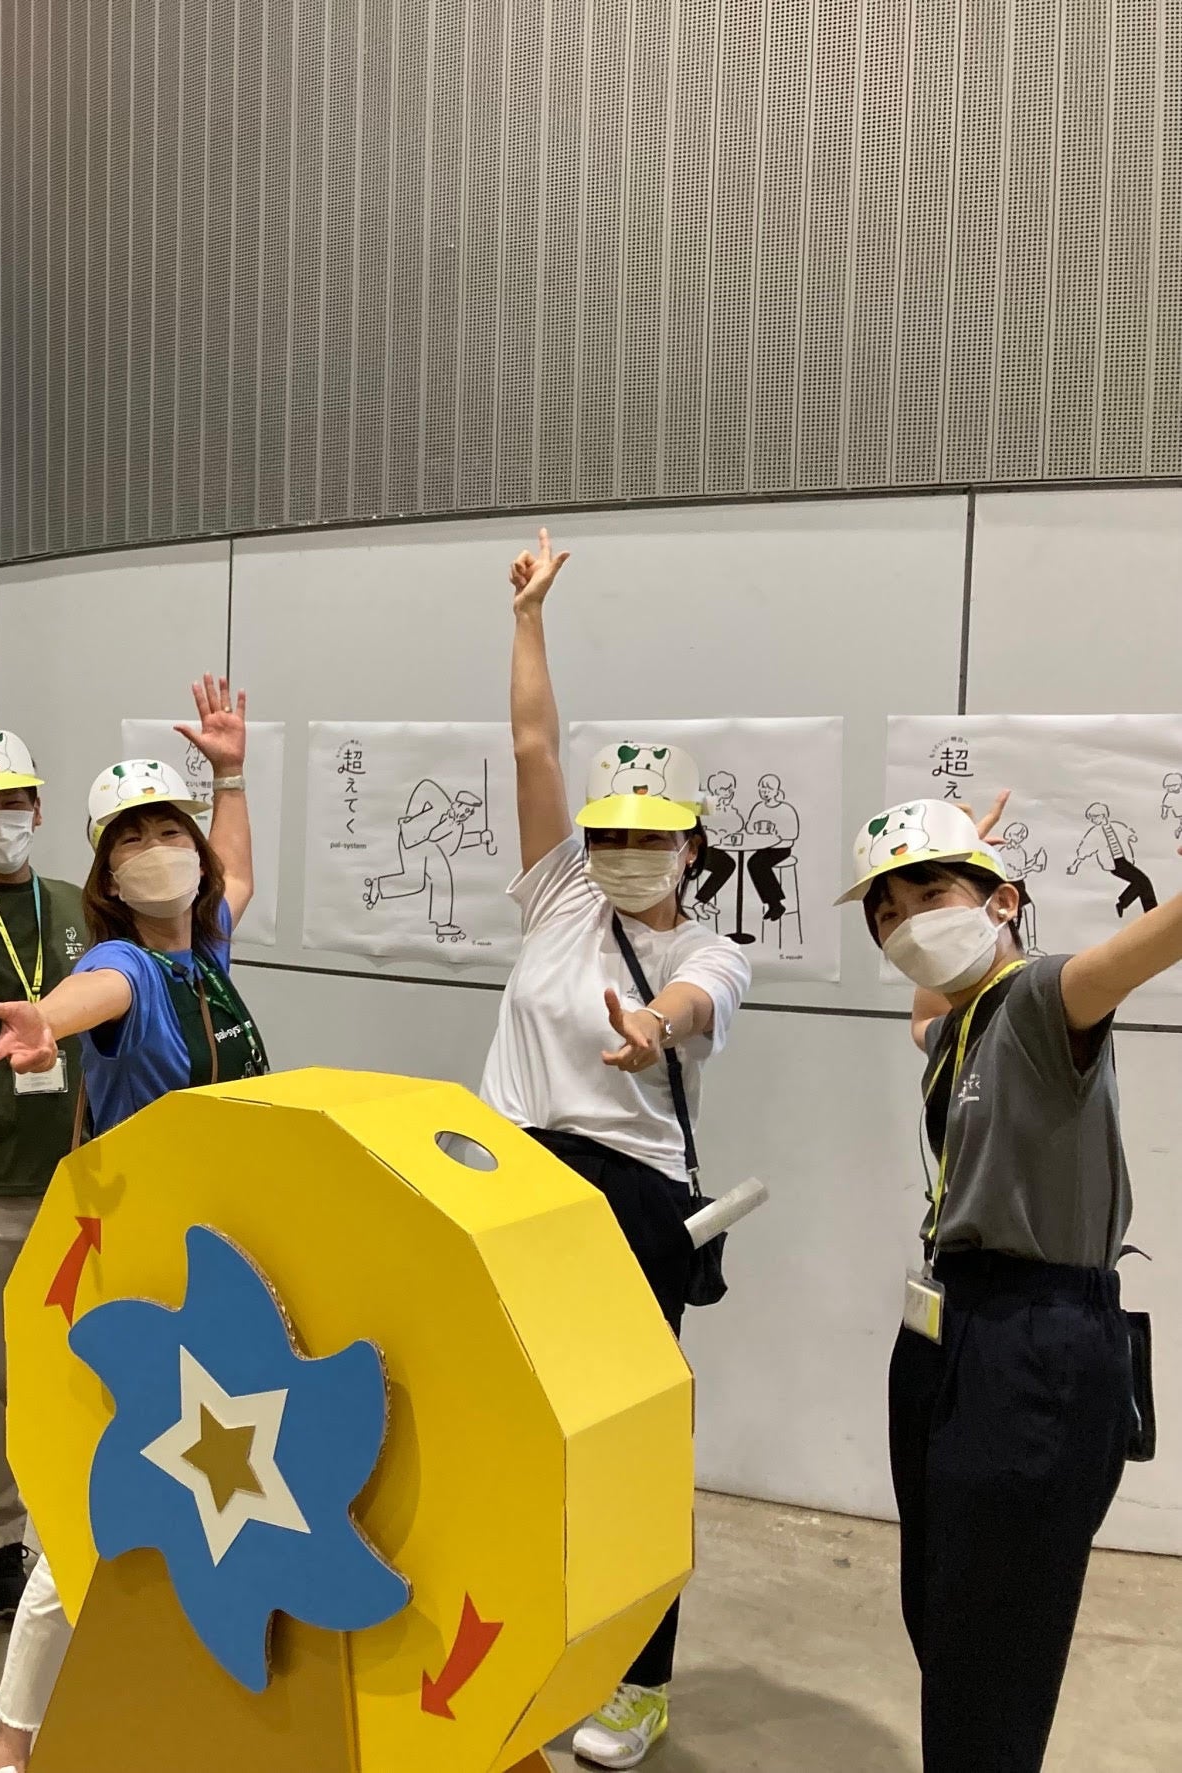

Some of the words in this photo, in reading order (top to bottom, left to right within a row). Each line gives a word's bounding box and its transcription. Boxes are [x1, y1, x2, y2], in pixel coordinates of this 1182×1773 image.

[337, 748, 366, 834] 超えてく
[932, 747, 974, 799] 超え
